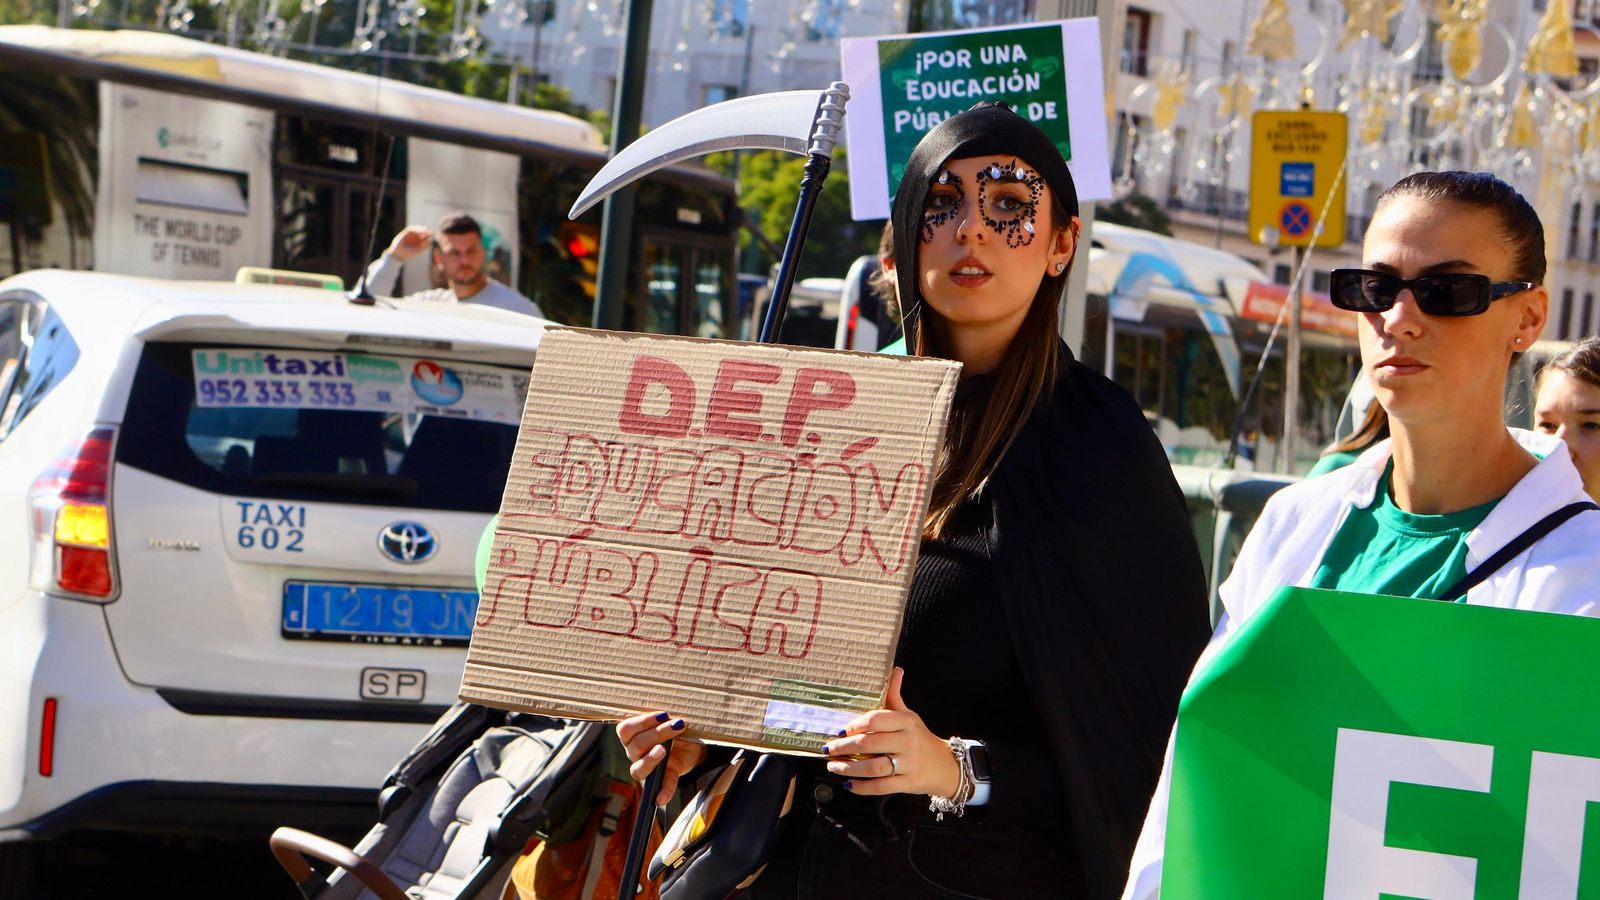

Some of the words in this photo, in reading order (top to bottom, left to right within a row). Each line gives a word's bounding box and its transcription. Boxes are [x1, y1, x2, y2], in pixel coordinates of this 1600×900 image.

[915, 49, 972, 75] ¡POR
[980, 44, 1027, 65] UNA
[906, 68, 1041, 101] EDUCACIÓN
[1027, 101, 1058, 122] DE
[134, 213, 159, 237] THE
[165, 218, 212, 242] WORLD
[215, 223, 242, 246] CUP
[152, 241, 168, 262] OF
[174, 243, 221, 268] TENNIS
[195, 352, 345, 377] Unitaxi
[199, 379, 248, 404] 952
[254, 380, 303, 405] 333
[308, 382, 357, 407] 333
[236, 501, 307, 528] TAXI
[237, 526, 304, 552] 602
[322, 591, 414, 629] 1219
[430, 596, 477, 631] JN
[368, 672, 418, 696] SP
